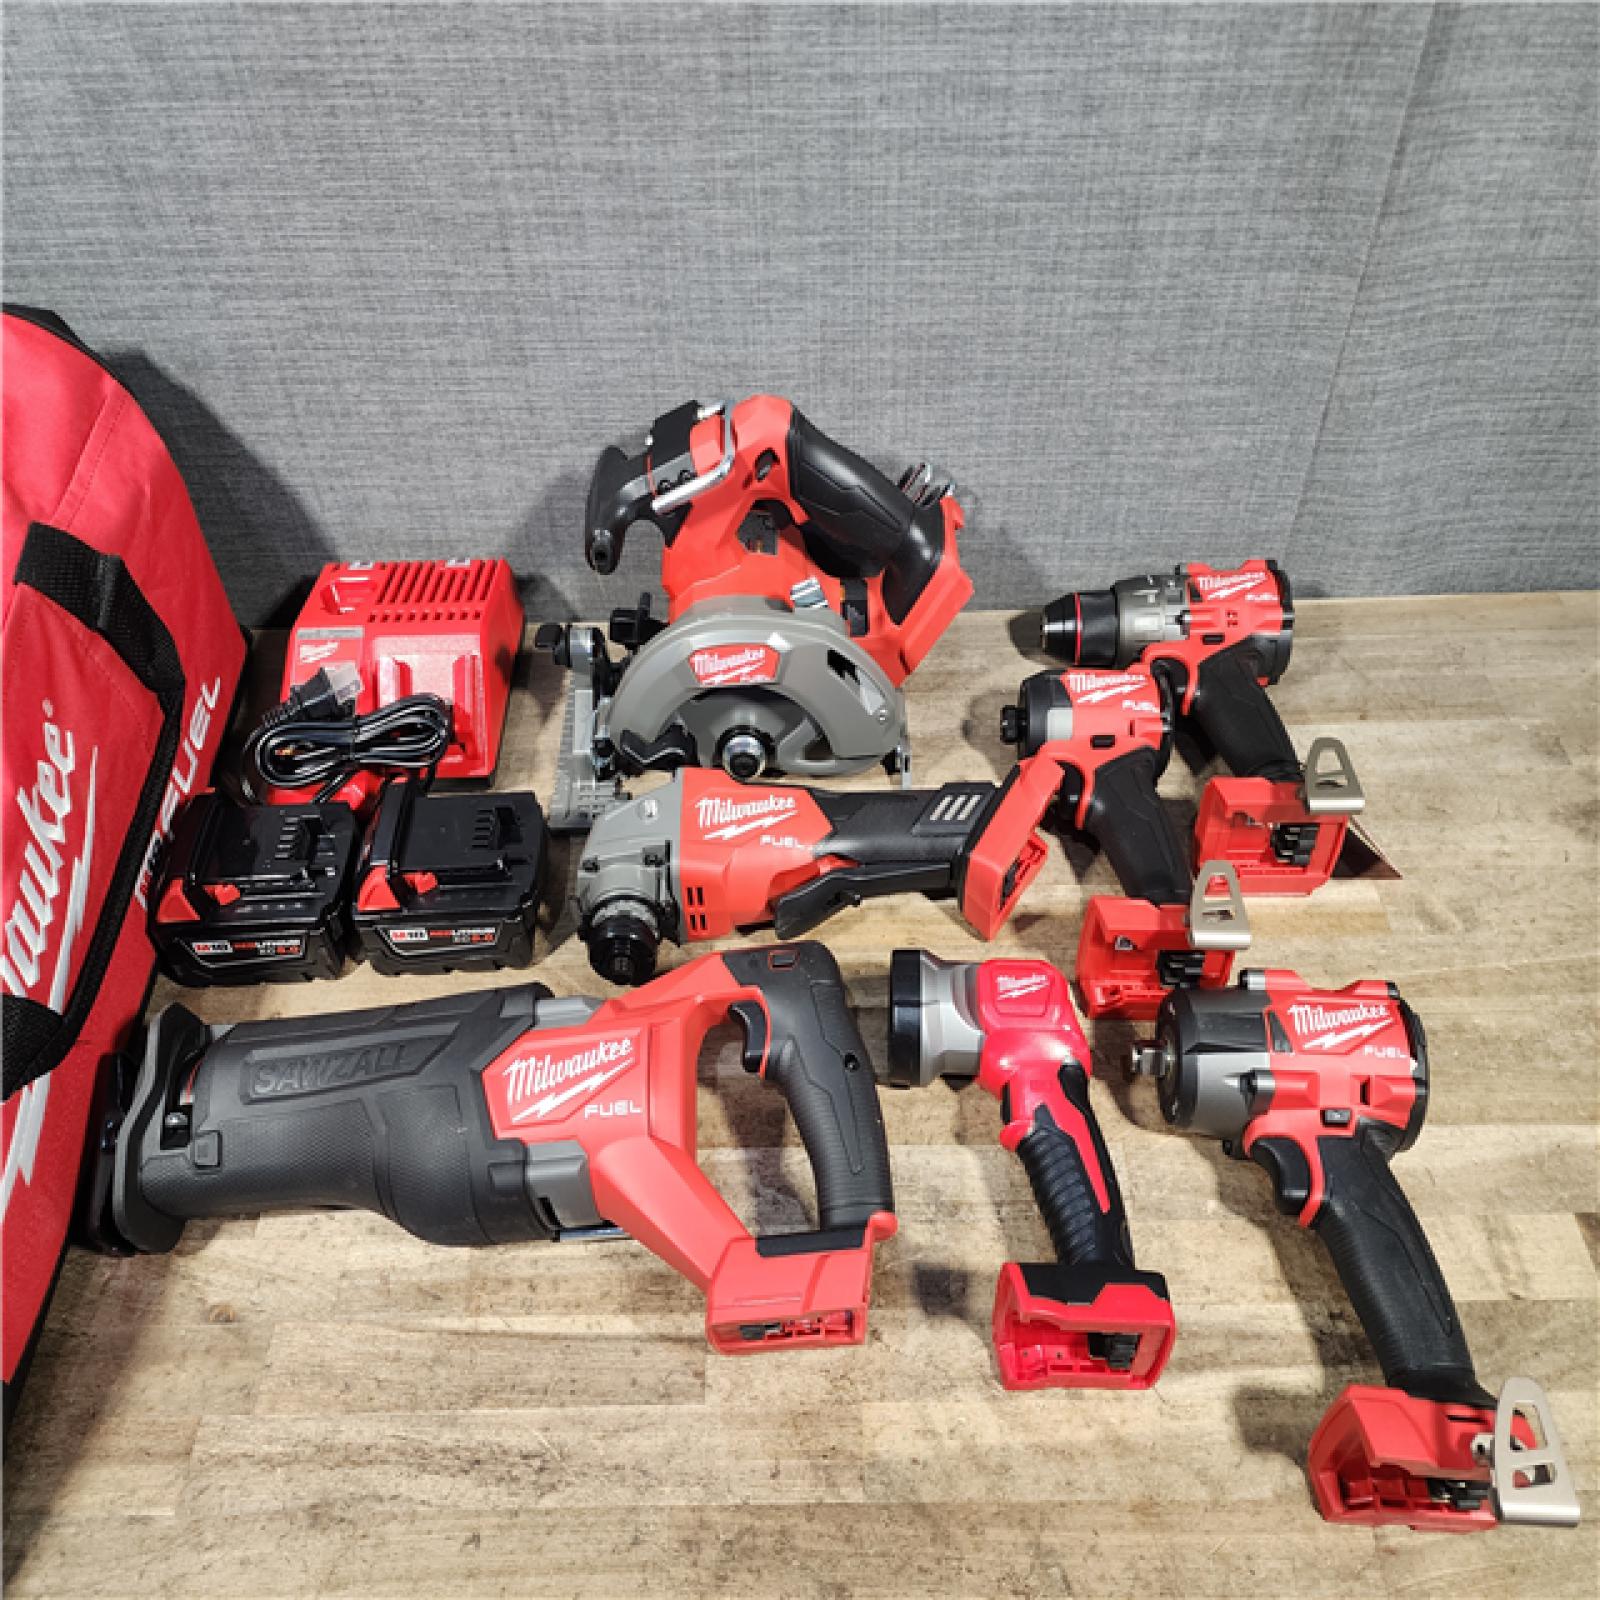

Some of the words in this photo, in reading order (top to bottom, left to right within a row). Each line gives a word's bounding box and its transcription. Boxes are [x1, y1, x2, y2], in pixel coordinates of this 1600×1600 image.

[695, 794, 796, 829] Milwaukee
[1287, 1002, 1388, 1036] Milwaukee
[1363, 1046, 1407, 1058] FUEL
[502, 1037, 632, 1105] Milwaukee
[584, 1100, 641, 1118] FUEL
